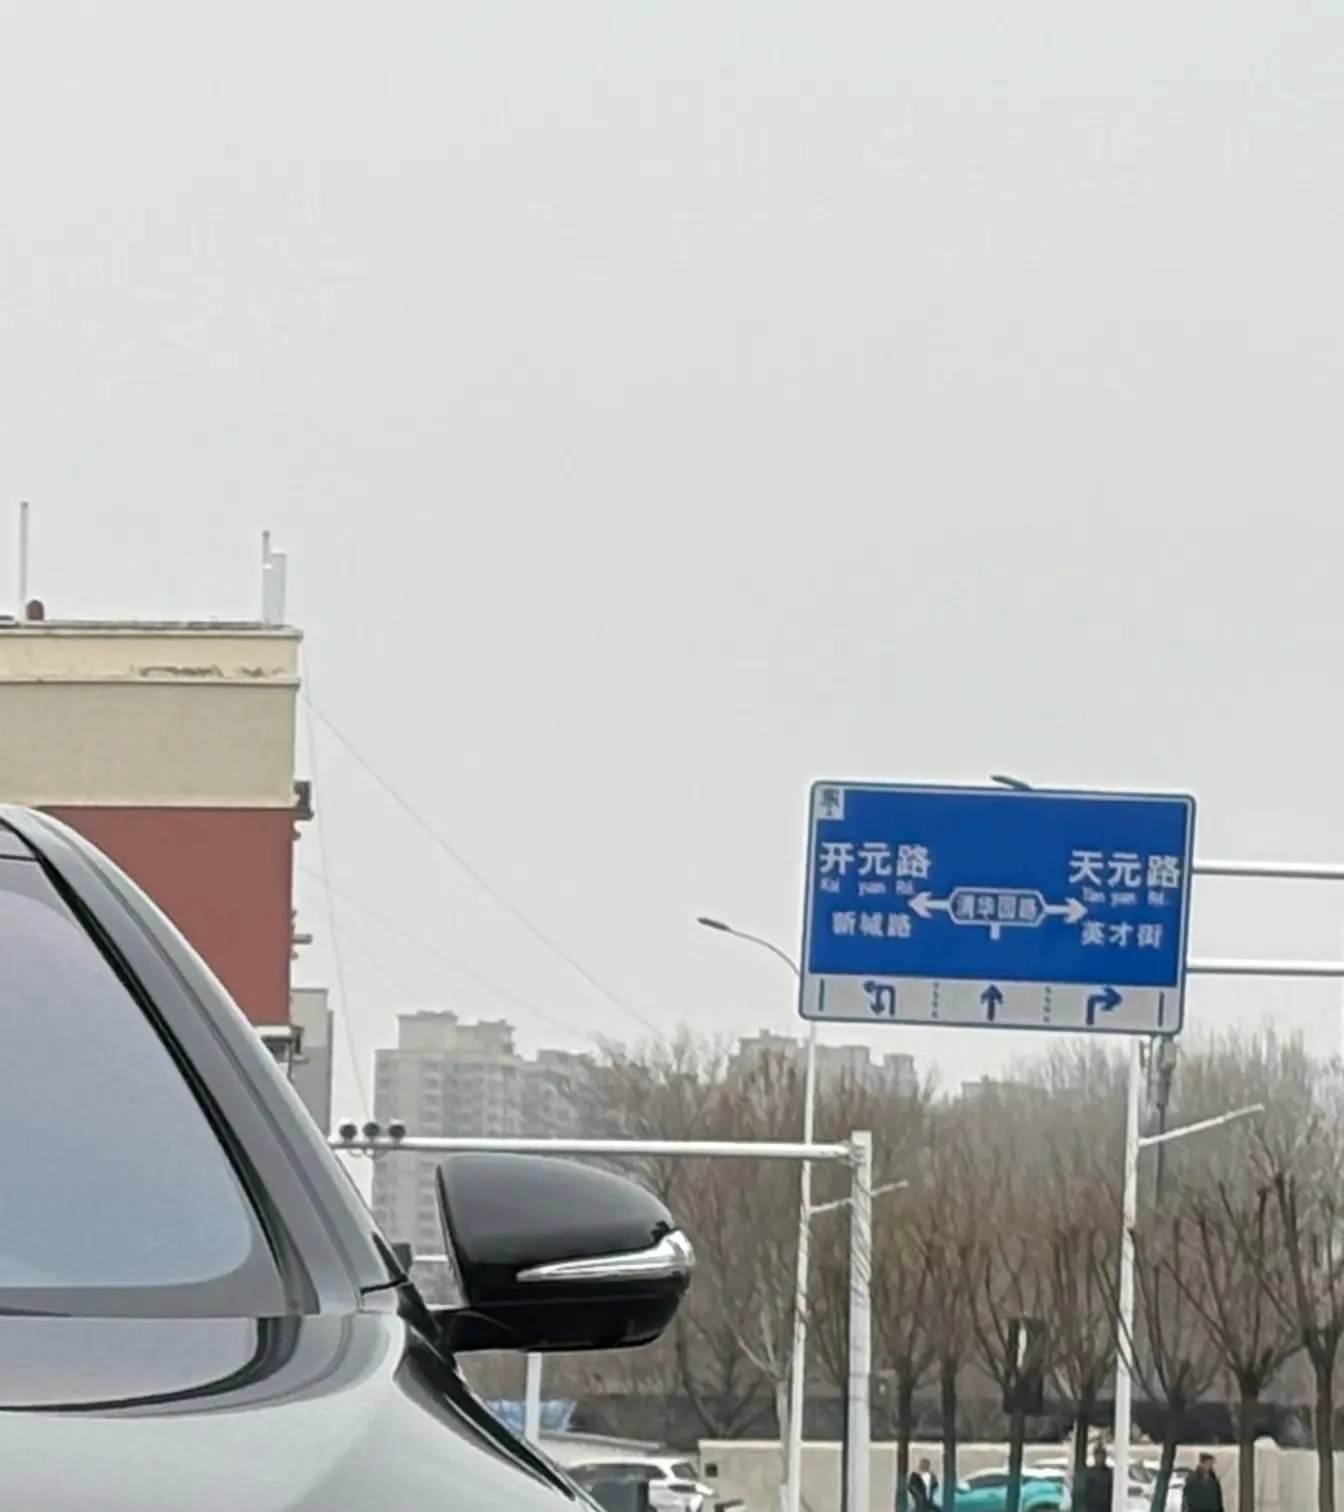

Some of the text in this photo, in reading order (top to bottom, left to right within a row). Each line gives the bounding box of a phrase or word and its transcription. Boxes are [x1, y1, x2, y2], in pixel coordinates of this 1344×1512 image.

[819, 841, 932, 880] 开元路
[1068, 849, 1181, 889] 天元路
[1080, 920, 1164, 949] 英才街
